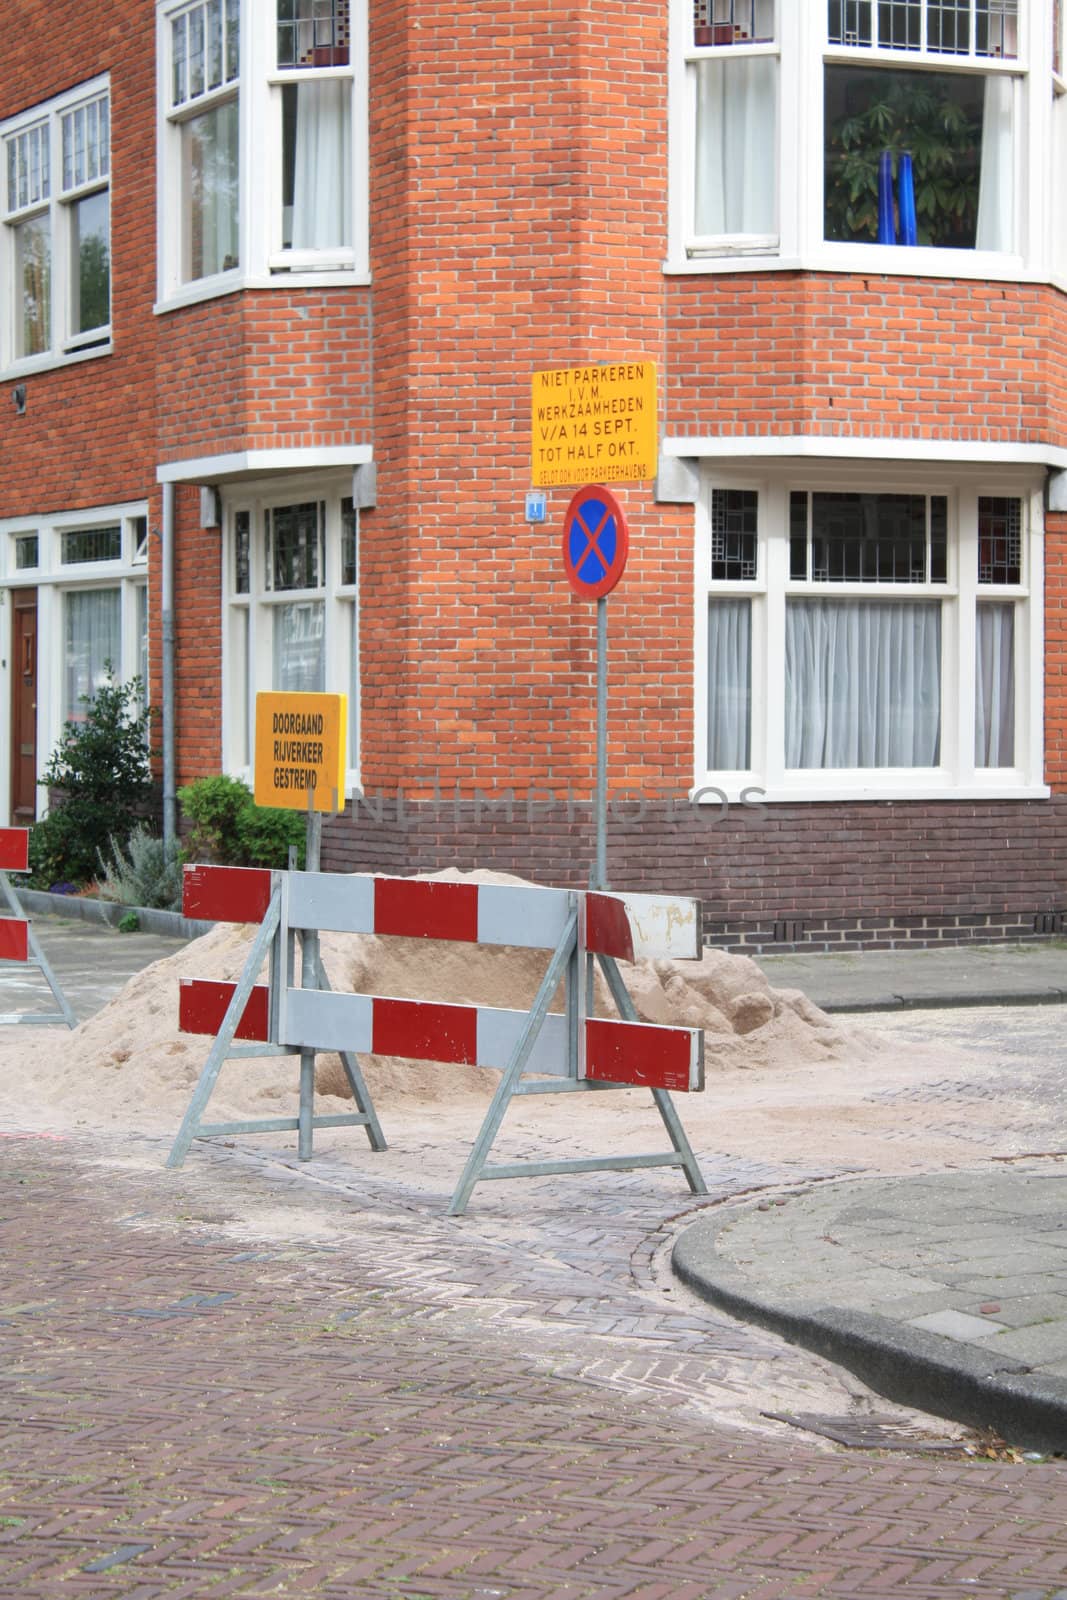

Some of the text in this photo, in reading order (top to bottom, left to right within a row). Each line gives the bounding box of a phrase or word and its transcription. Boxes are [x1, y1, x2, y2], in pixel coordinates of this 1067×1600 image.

[541, 365, 644, 387] NIET PARKEREN
[569, 386, 603, 402] I.V.M.
[538, 397, 643, 421] WERKZAAMHEDEN
[541, 419, 638, 441] V/A 14 SEPT.
[539, 441, 639, 462] TOT HALF OKT.
[273, 713, 323, 735] DOORGAAND
[273, 741, 323, 764] RIJVERKEER
[274, 768, 316, 790] GESTREMD
